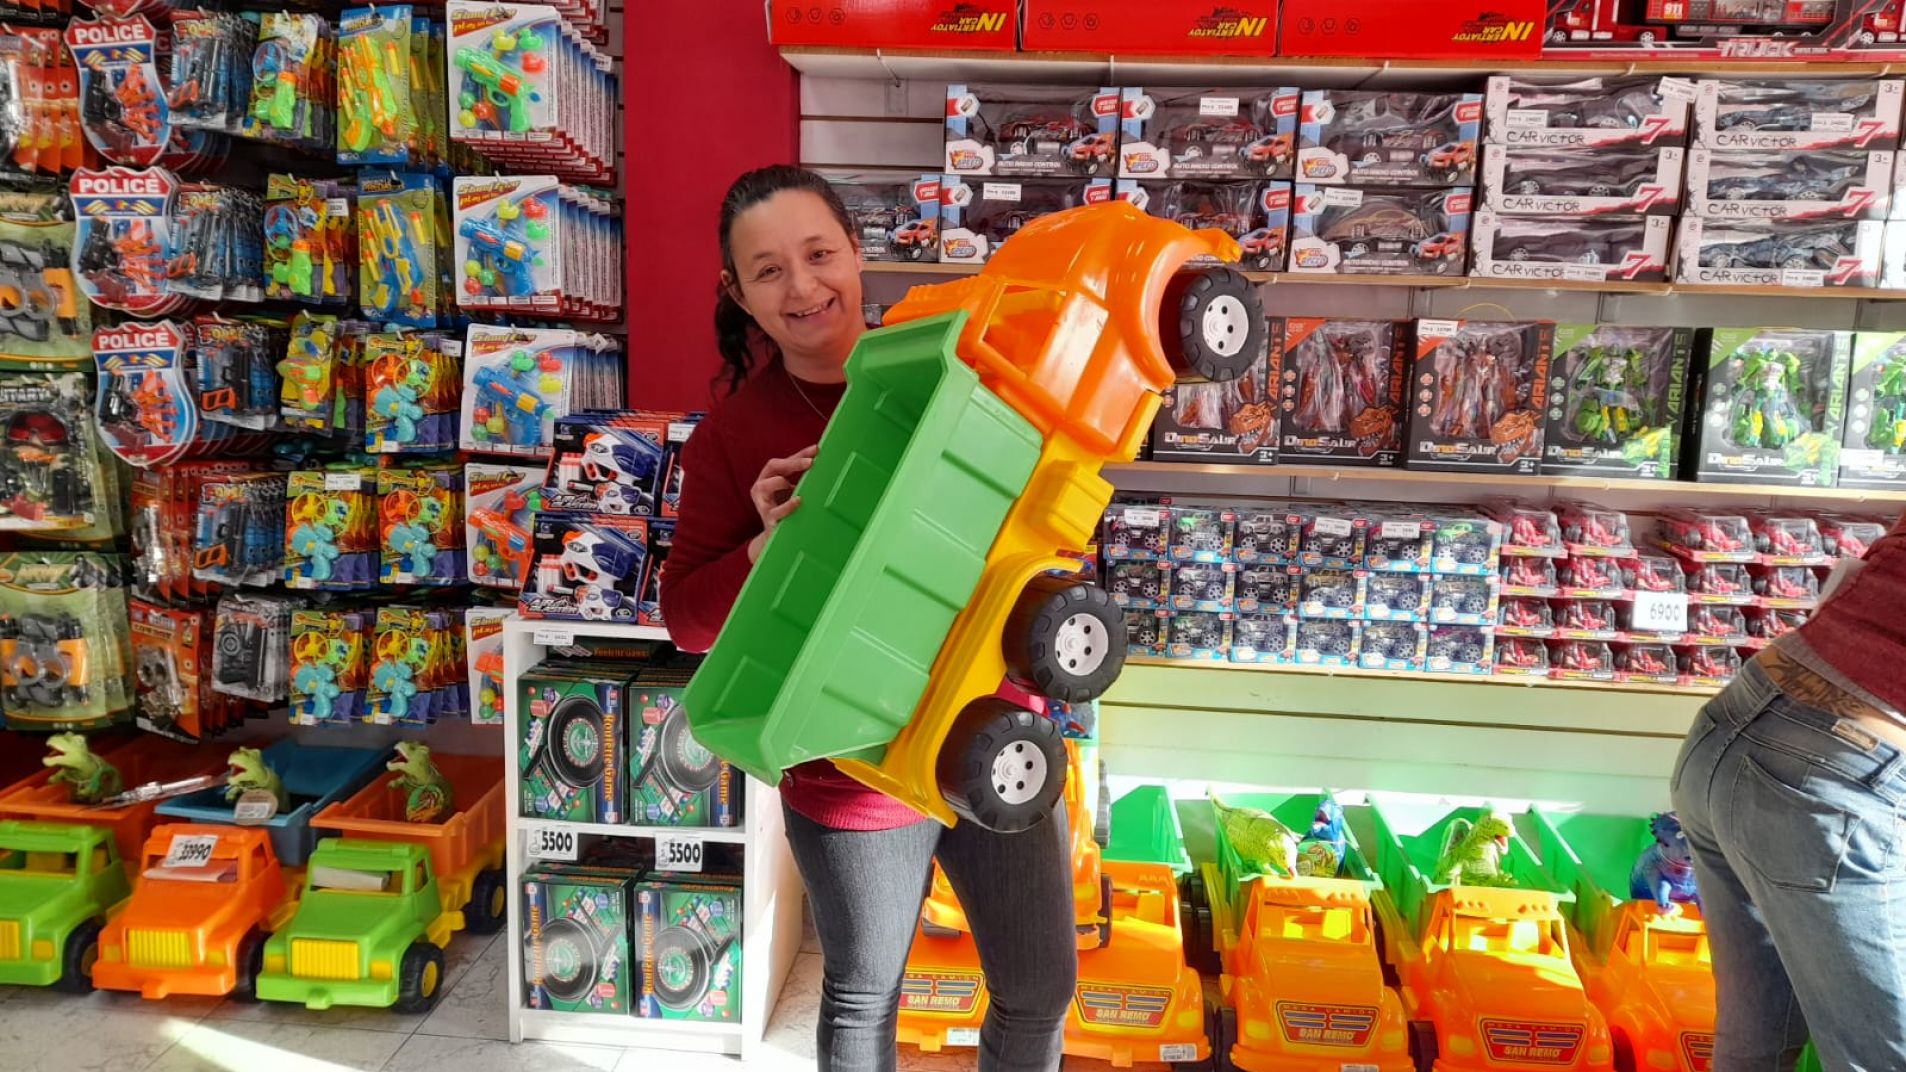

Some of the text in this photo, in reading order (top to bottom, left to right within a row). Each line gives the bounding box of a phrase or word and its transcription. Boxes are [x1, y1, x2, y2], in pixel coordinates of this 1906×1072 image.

[75, 24, 146, 44] POLICE
[1717, 40, 1802, 57] TRUCK
[1507, 131, 1585, 144] CAR VICTOR
[1640, 118, 1670, 144] 7
[1854, 121, 1885, 148] 7
[1716, 134, 1796, 147] CAR VICTOR
[79, 178, 161, 194] POLICE
[1503, 198, 1580, 211] CAR VICTOR
[1635, 187, 1664, 212] 7
[1844, 191, 1875, 217] 7
[1708, 203, 1787, 216] CAR VICTOR
[1492, 265, 1521, 276] CAR
[1622, 254, 1651, 279] 7
[1834, 260, 1862, 285] 7
[1700, 270, 1731, 281] CAR
[1735, 272, 1778, 283] VICTOR
[98, 333, 170, 349] POLICE
[1649, 602, 1681, 622] 6900
[603, 714, 615, 801] Roulette Game
[720, 771, 732, 804] Game
[541, 831, 573, 852] 5500
[669, 843, 701, 864] 5500
[530, 905, 542, 937] Game
[907, 995, 960, 1006] SAN REMO
[1096, 1009, 1151, 1021] SAN REMO
[1300, 1028, 1356, 1040] SAN REMO
[1504, 1046, 1561, 1058] SAN REMO
